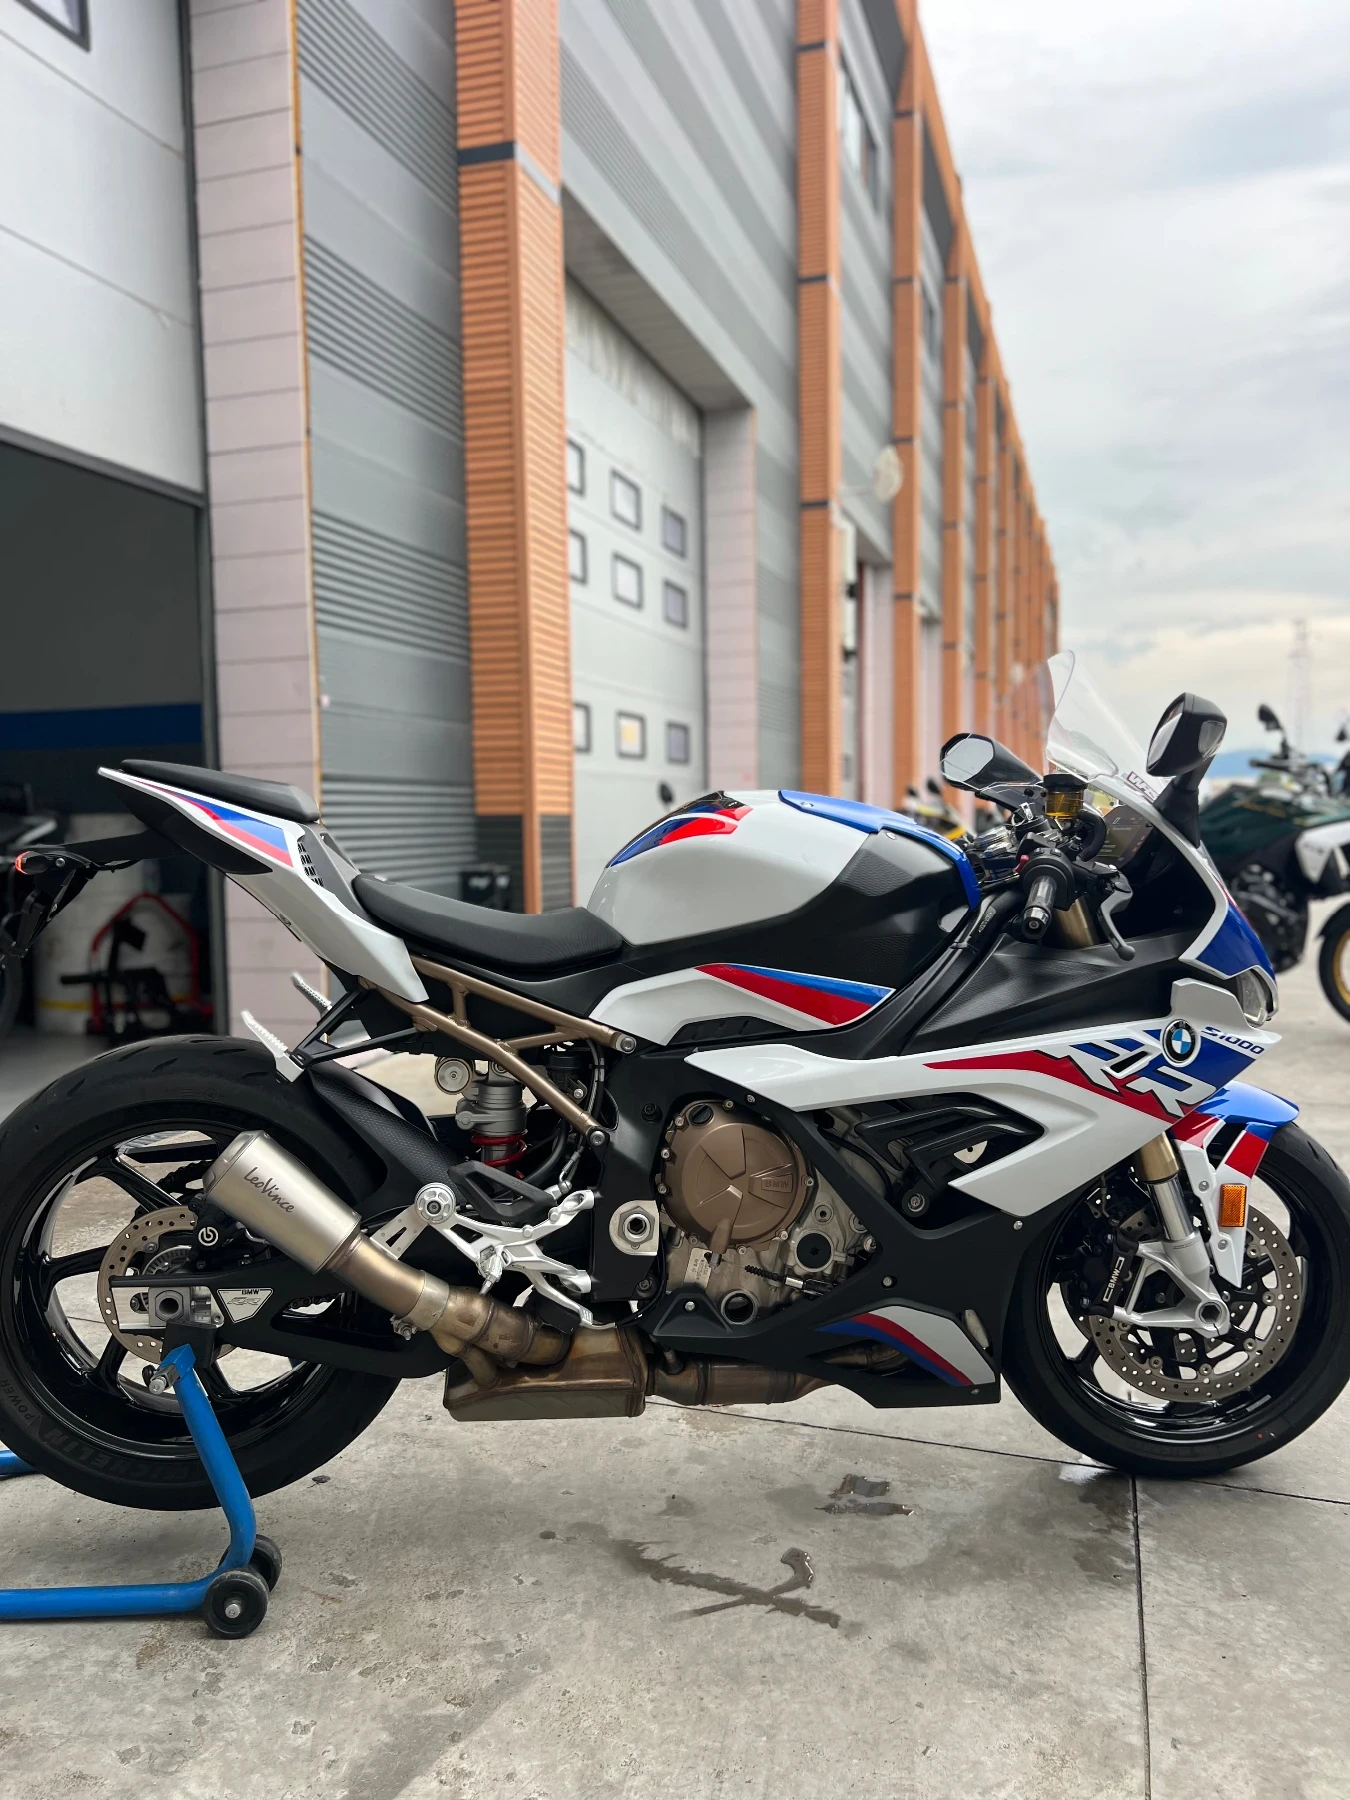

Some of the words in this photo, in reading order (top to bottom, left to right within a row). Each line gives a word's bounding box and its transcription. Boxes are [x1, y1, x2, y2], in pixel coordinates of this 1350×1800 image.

[1200, 1026, 1265, 1055] S1000
[243, 1166, 295, 1213] LeoVince
[765, 1180, 790, 1189] BMW
[1107, 1267, 1121, 1289] BMW
[0, 1379, 35, 1421] POWER
